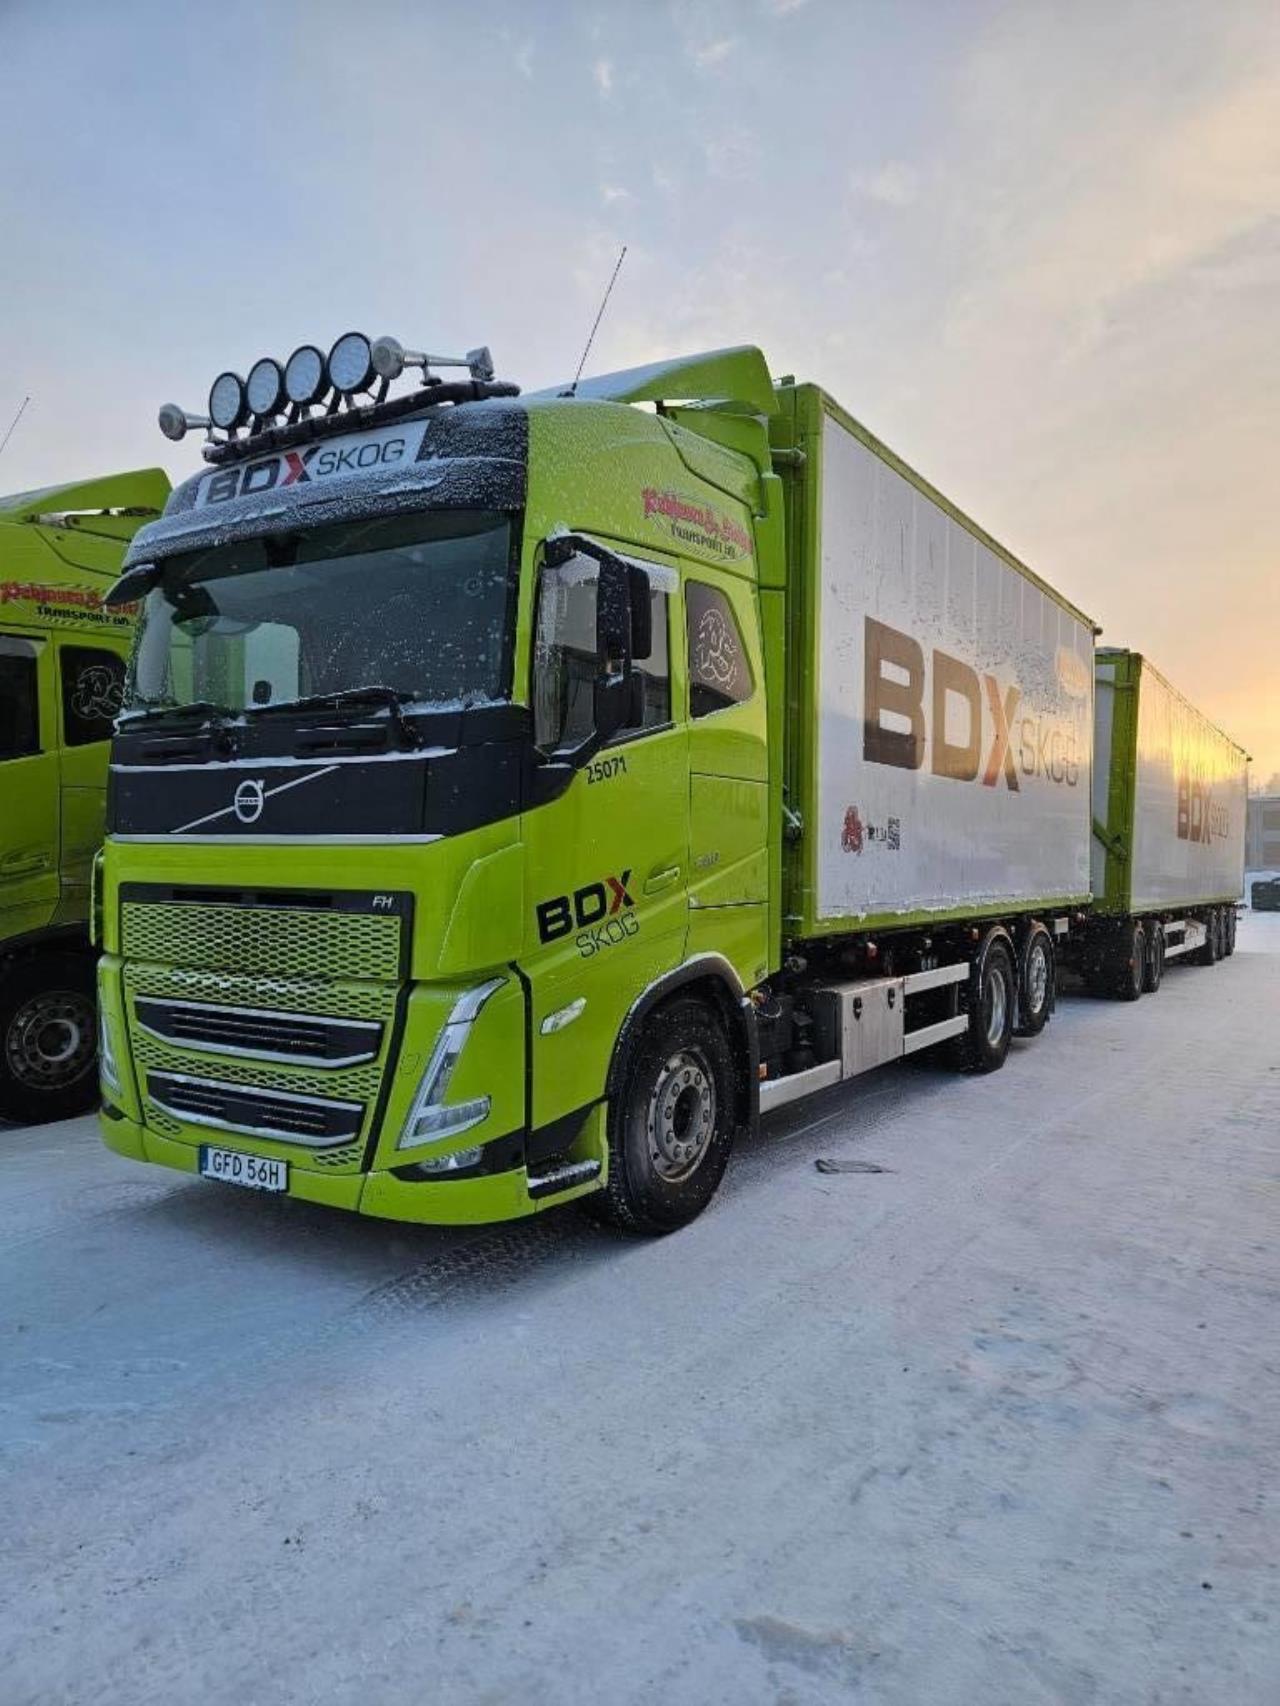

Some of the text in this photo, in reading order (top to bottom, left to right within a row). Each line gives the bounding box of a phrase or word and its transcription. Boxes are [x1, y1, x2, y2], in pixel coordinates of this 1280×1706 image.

[205, 439, 405, 504] BDX SKOG
[863, 616, 1020, 792] BDX
[584, 755, 627, 785] 25071
[372, 895, 393, 909] FH
[536, 869, 635, 945] BDX
[576, 912, 639, 958] SKOG
[212, 1152, 279, 1185] GFD 56H
